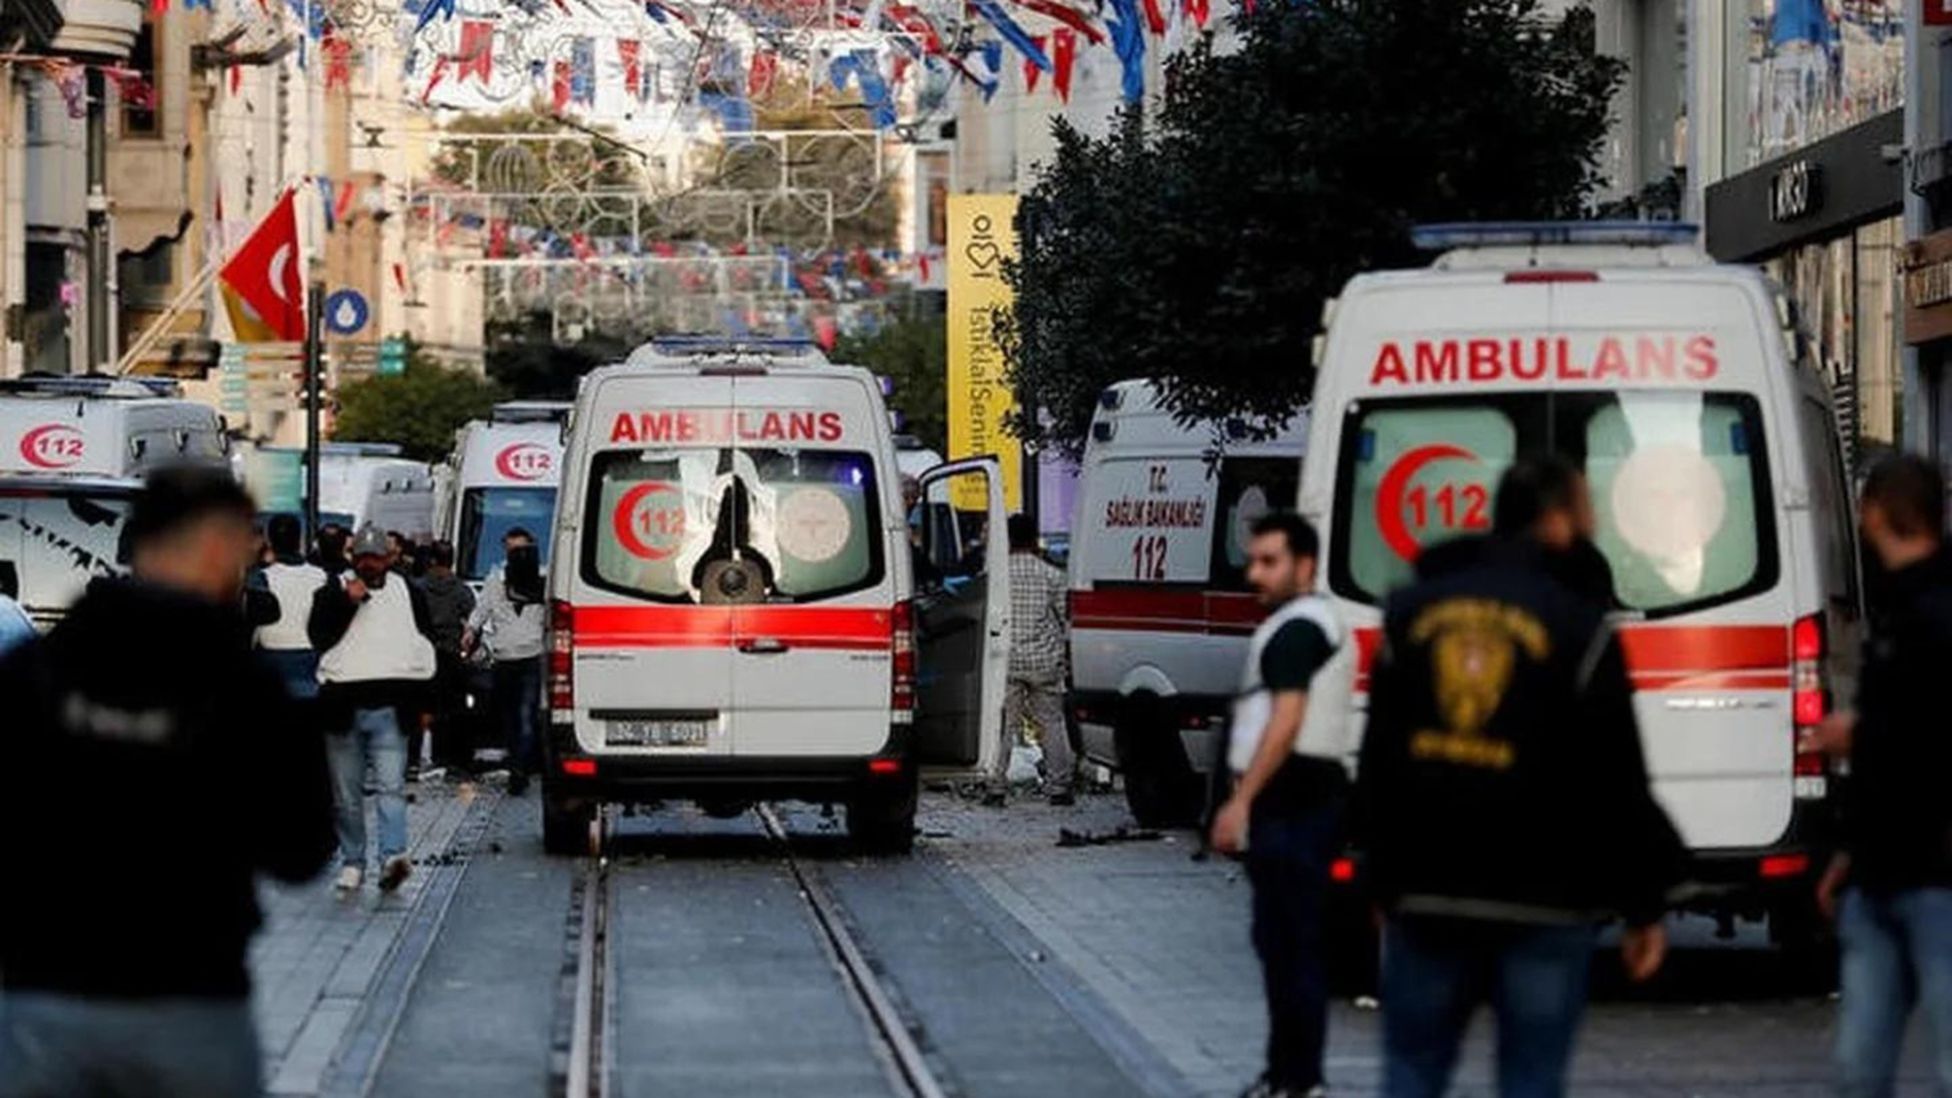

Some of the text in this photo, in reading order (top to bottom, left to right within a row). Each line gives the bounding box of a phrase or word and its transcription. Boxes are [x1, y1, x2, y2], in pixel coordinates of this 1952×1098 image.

[1369, 336, 1719, 385] AMBULANS
[610, 412, 843, 443] AMBULANS
[38, 438, 84, 457] 112
[512, 453, 550, 470] 112
[640, 508, 687, 536] 112
[1407, 483, 1493, 531] 112
[1132, 535, 1168, 580] 112
